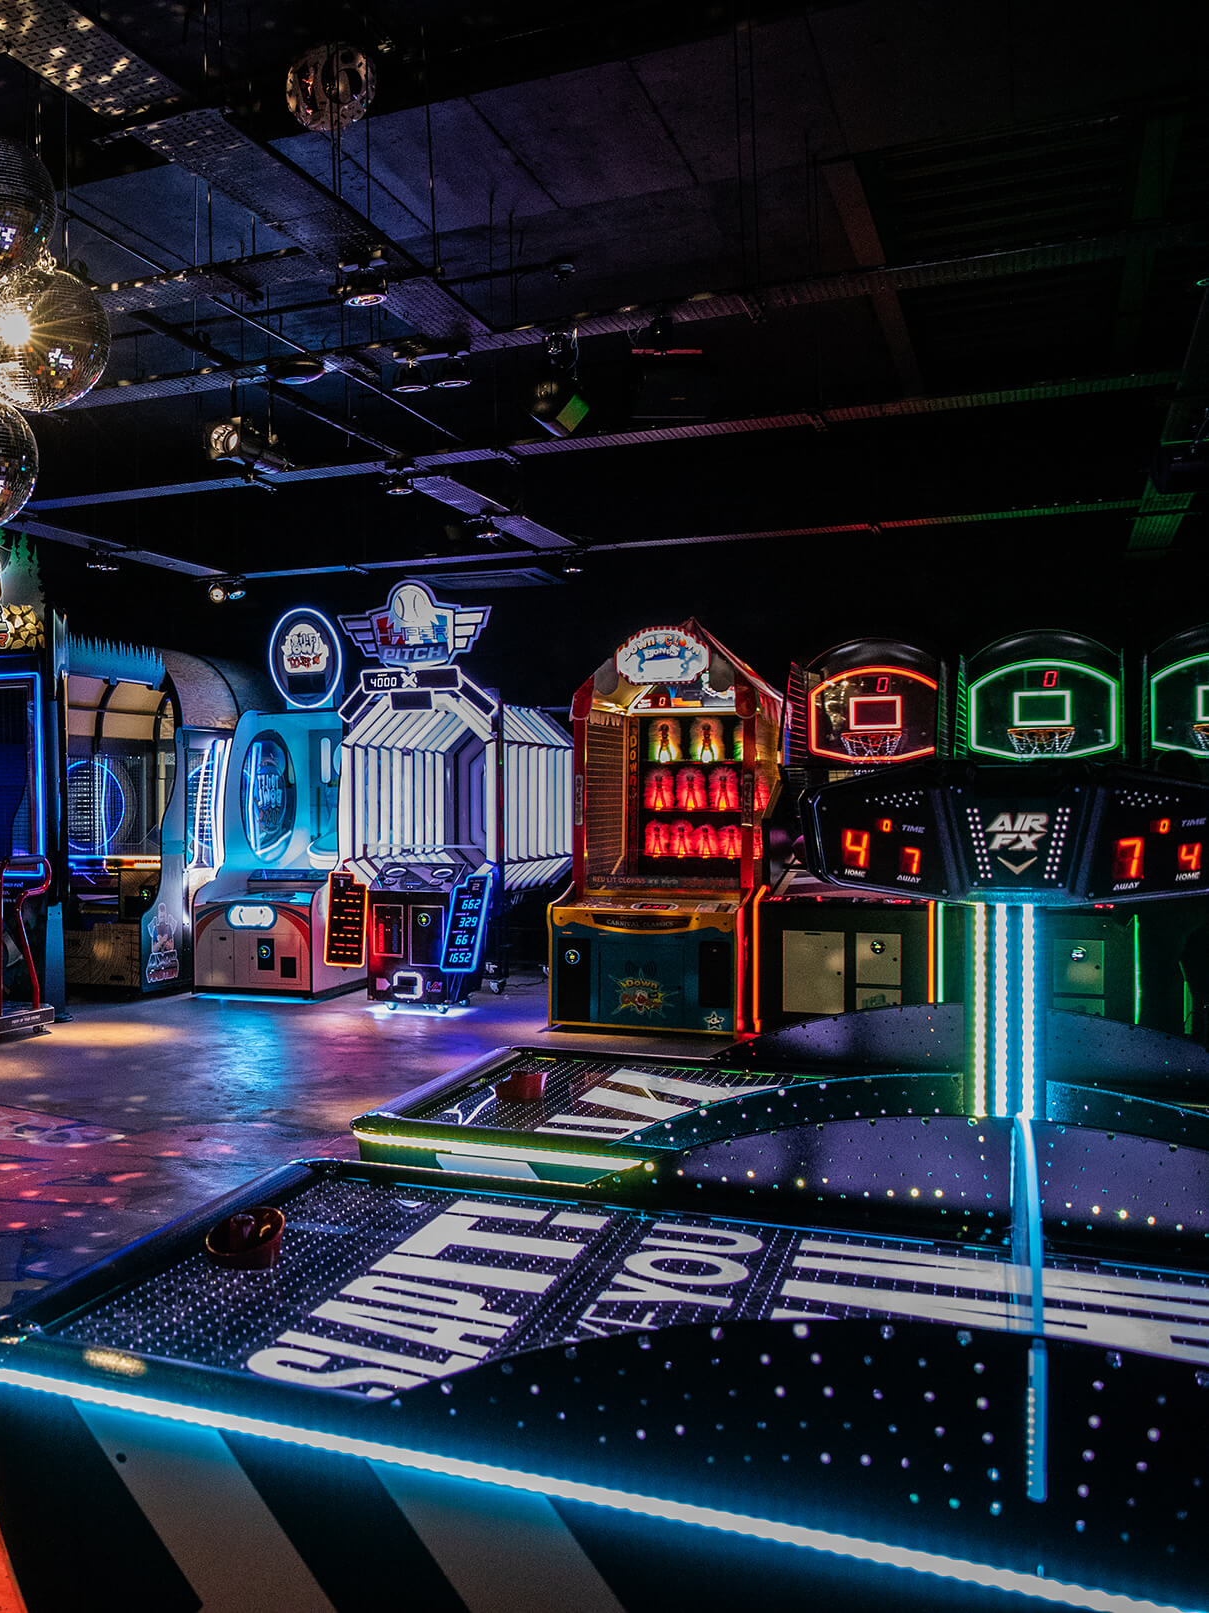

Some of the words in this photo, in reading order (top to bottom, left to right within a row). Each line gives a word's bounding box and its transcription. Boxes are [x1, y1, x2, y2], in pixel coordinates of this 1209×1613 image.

[382, 646, 443, 660] PITCH
[370, 676, 397, 688] 4000
[876, 677, 889, 692] 0
[1043, 670, 1058, 687] 0
[882, 819, 892, 832] 0
[985, 811, 1048, 832] AIR
[1159, 818, 1170, 834] 0
[1181, 817, 1207, 827] TIME
[902, 824, 925, 834] TIME
[989, 833, 1047, 851] FX
[845, 829, 870, 868] 4
[903, 846, 921, 874] 7
[1118, 837, 1144, 879] 7
[1180, 843, 1201, 871] 4
[844, 868, 867, 878] HOME
[896, 874, 922, 884] AWAY
[1175, 871, 1201, 881] HOME
[1112, 881, 1141, 891] AWAY
[462, 899, 481, 909] 662
[458, 917, 478, 927] 329
[606, 919, 640, 927] CARNIVAL
[455, 935, 475, 945] 661
[449, 953, 472, 963] 1652
[596, 1222, 764, 1308] YOU
